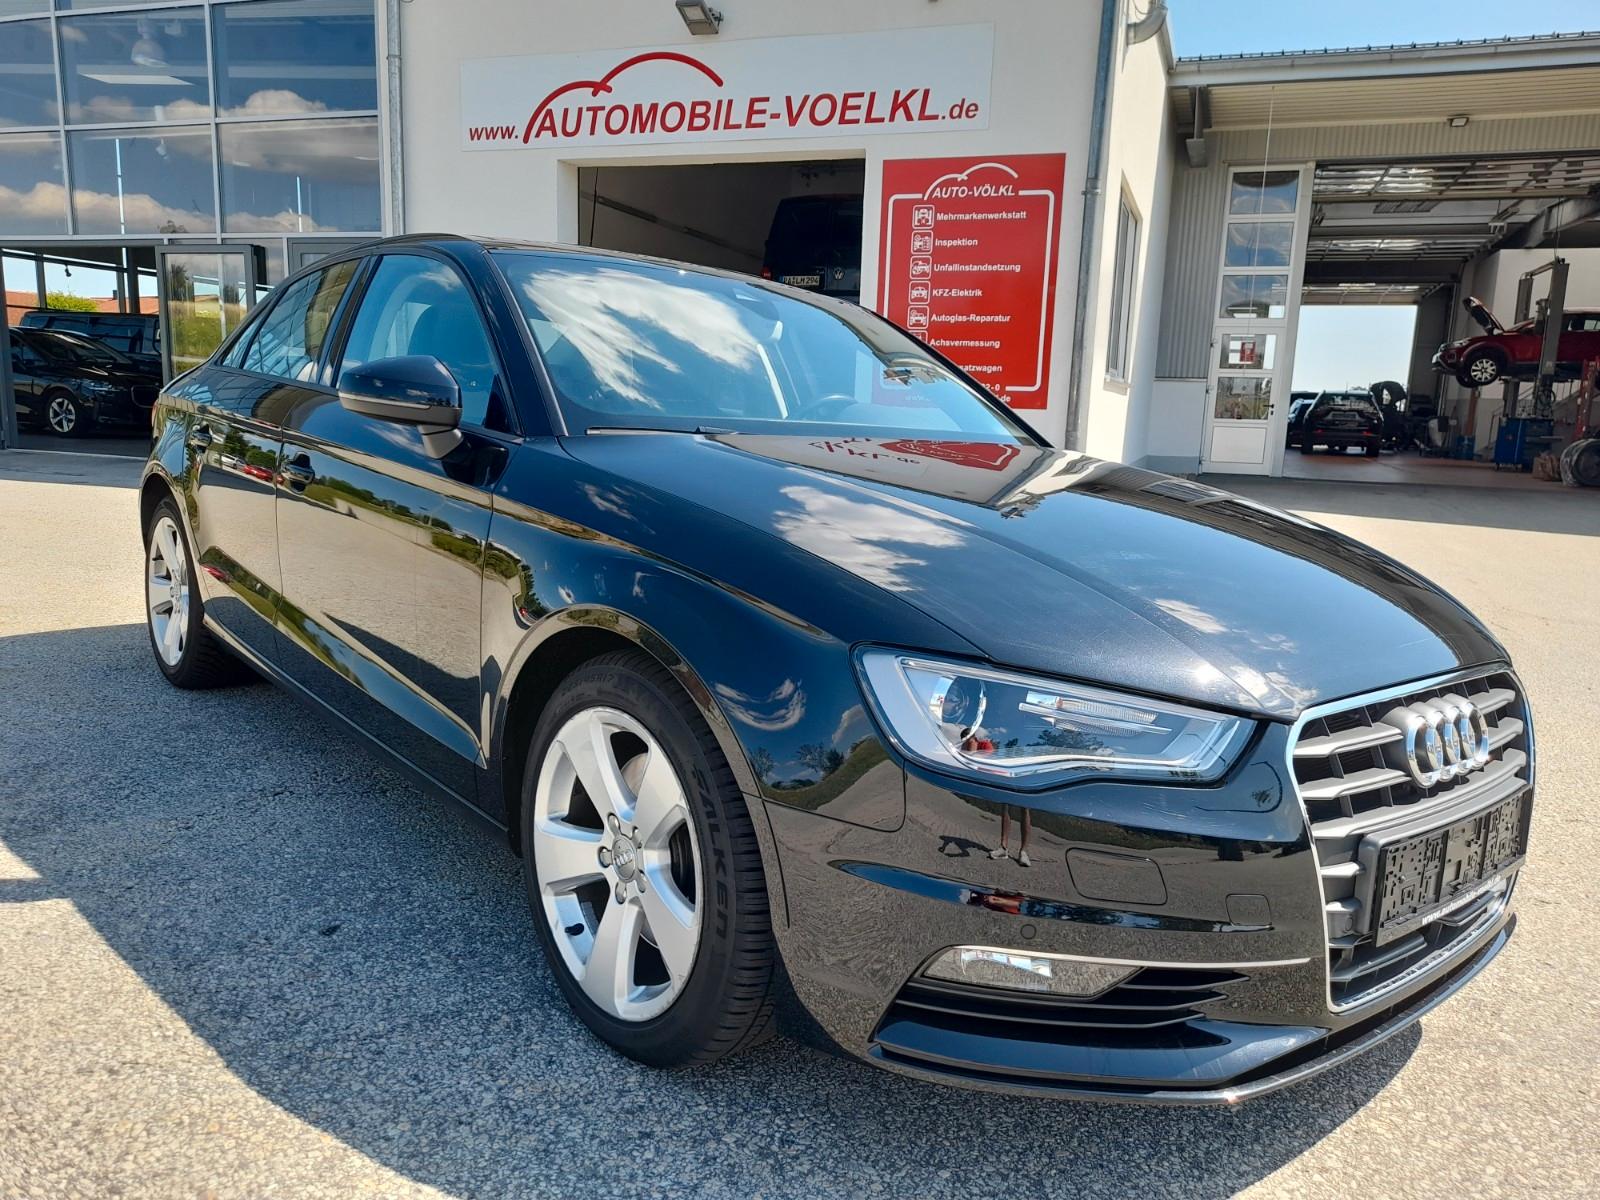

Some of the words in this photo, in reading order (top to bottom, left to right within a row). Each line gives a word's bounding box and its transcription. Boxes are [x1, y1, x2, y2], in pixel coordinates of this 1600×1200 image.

[932, 184, 1016, 198] AUTO-VÖLKL
[936, 210, 1027, 221] Mehrmarkenwerkstatt
[935, 237, 978, 248] Inspektion
[933, 263, 1021, 273] Unfallinstandsetzung
[932, 288, 983, 297] KFZ-Elektrik
[930, 314, 1011, 323] Autoglas-Reparatur
[929, 338, 1000, 348] Achsvermessung
